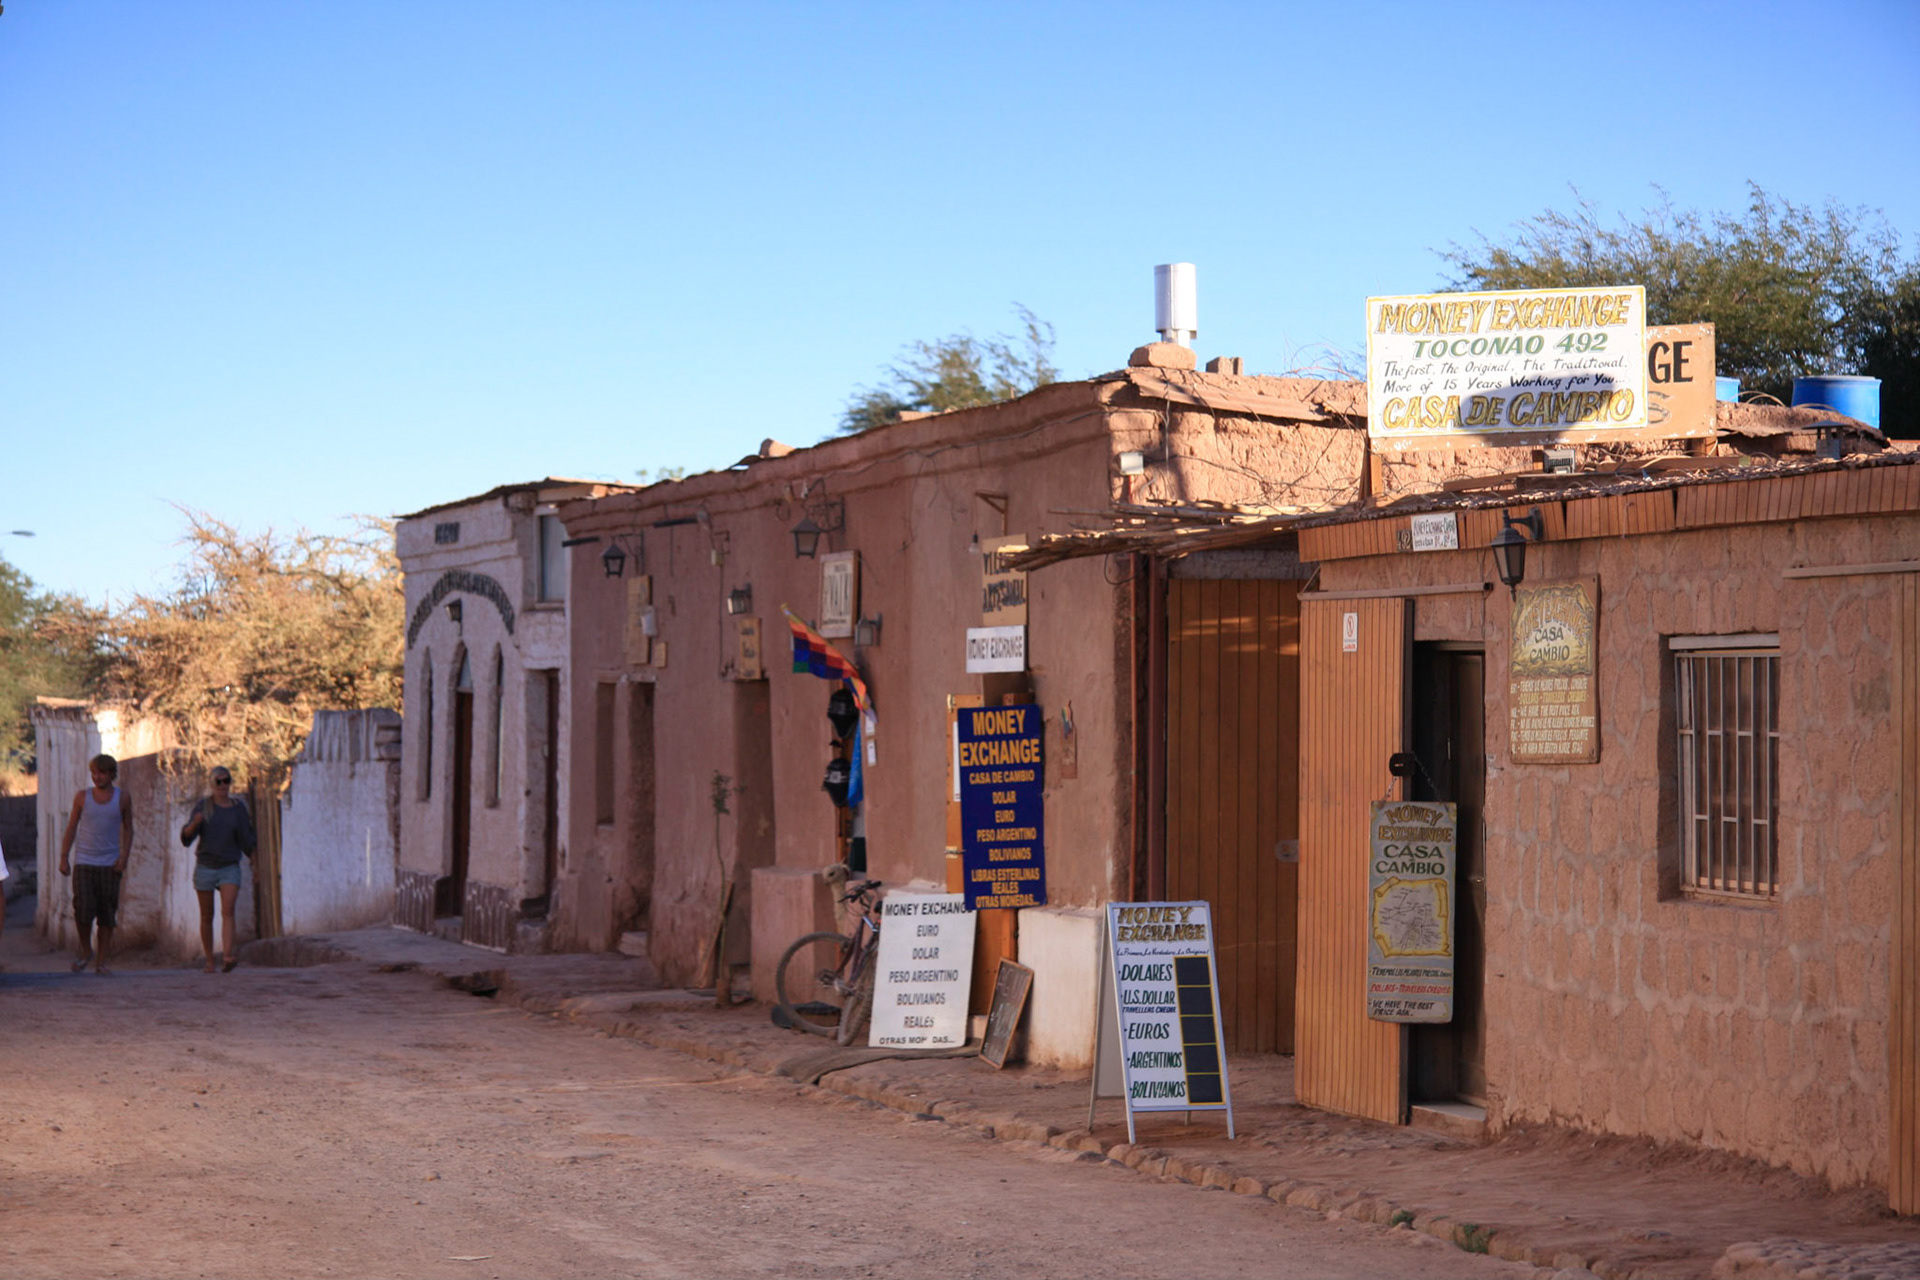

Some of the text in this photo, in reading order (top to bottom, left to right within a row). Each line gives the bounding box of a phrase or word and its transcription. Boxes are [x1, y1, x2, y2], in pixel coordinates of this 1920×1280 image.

[1377, 294, 1632, 335] MONEY EXCHANGE
[1413, 332, 1609, 359] TOCONAO 492
[1384, 361, 1404, 377] The
[1383, 379, 1412, 394] More
[1443, 378, 1458, 391] 15
[1467, 376, 1503, 390] Years
[1509, 374, 1562, 390] Working
[1565, 375, 1590, 390] for
[1382, 388, 1635, 430] CASA DE CAMBIO
[1534, 626, 1565, 643] CASA
[1529, 644, 1571, 662] CAMBIO
[972, 709, 1026, 736] MONEY
[959, 738, 1041, 767] EXCHANGE
[969, 769, 1035, 784] CASA DE CAMBIO
[992, 790, 1017, 804] DOLAR
[995, 809, 1016, 823] EURO
[1384, 804, 1444, 826] MONEY
[976, 827, 1037, 842] PESO ARGENTINO
[1378, 824, 1454, 843] EXCHANGE
[988, 847, 1032, 862] BOLIVIANOS
[1383, 844, 1445, 859] CASA
[971, 867, 1040, 882] LIBRAS ESTERLINAS
[1375, 860, 1446, 876] CAMBIO
[992, 881, 1019, 895] REALES
[885, 903, 919, 916] MONEY
[975, 895, 999, 909] OTRAS
[1117, 906, 1193, 924] MONEY
[917, 924, 939, 938] EURO
[1117, 924, 1206, 942] EXCHANGE
[912, 947, 939, 960] DOLAR
[889, 970, 958, 983] PESO ARGENTINO
[1121, 964, 1173, 981] DOLARES
[896, 993, 946, 1006] BOLIVIANOS
[1384, 1000, 1401, 1009] HAVE
[1404, 1001, 1416, 1009] THE
[1417, 1002, 1435, 1010] BEST
[903, 1016, 935, 1029] REALES
[1128, 1022, 1170, 1040] EUROS
[879, 1036, 906, 1045] OTRAS
[1130, 1051, 1183, 1069] ARGENTINOS
[1131, 1080, 1187, 1098] BOLIVIANOS
